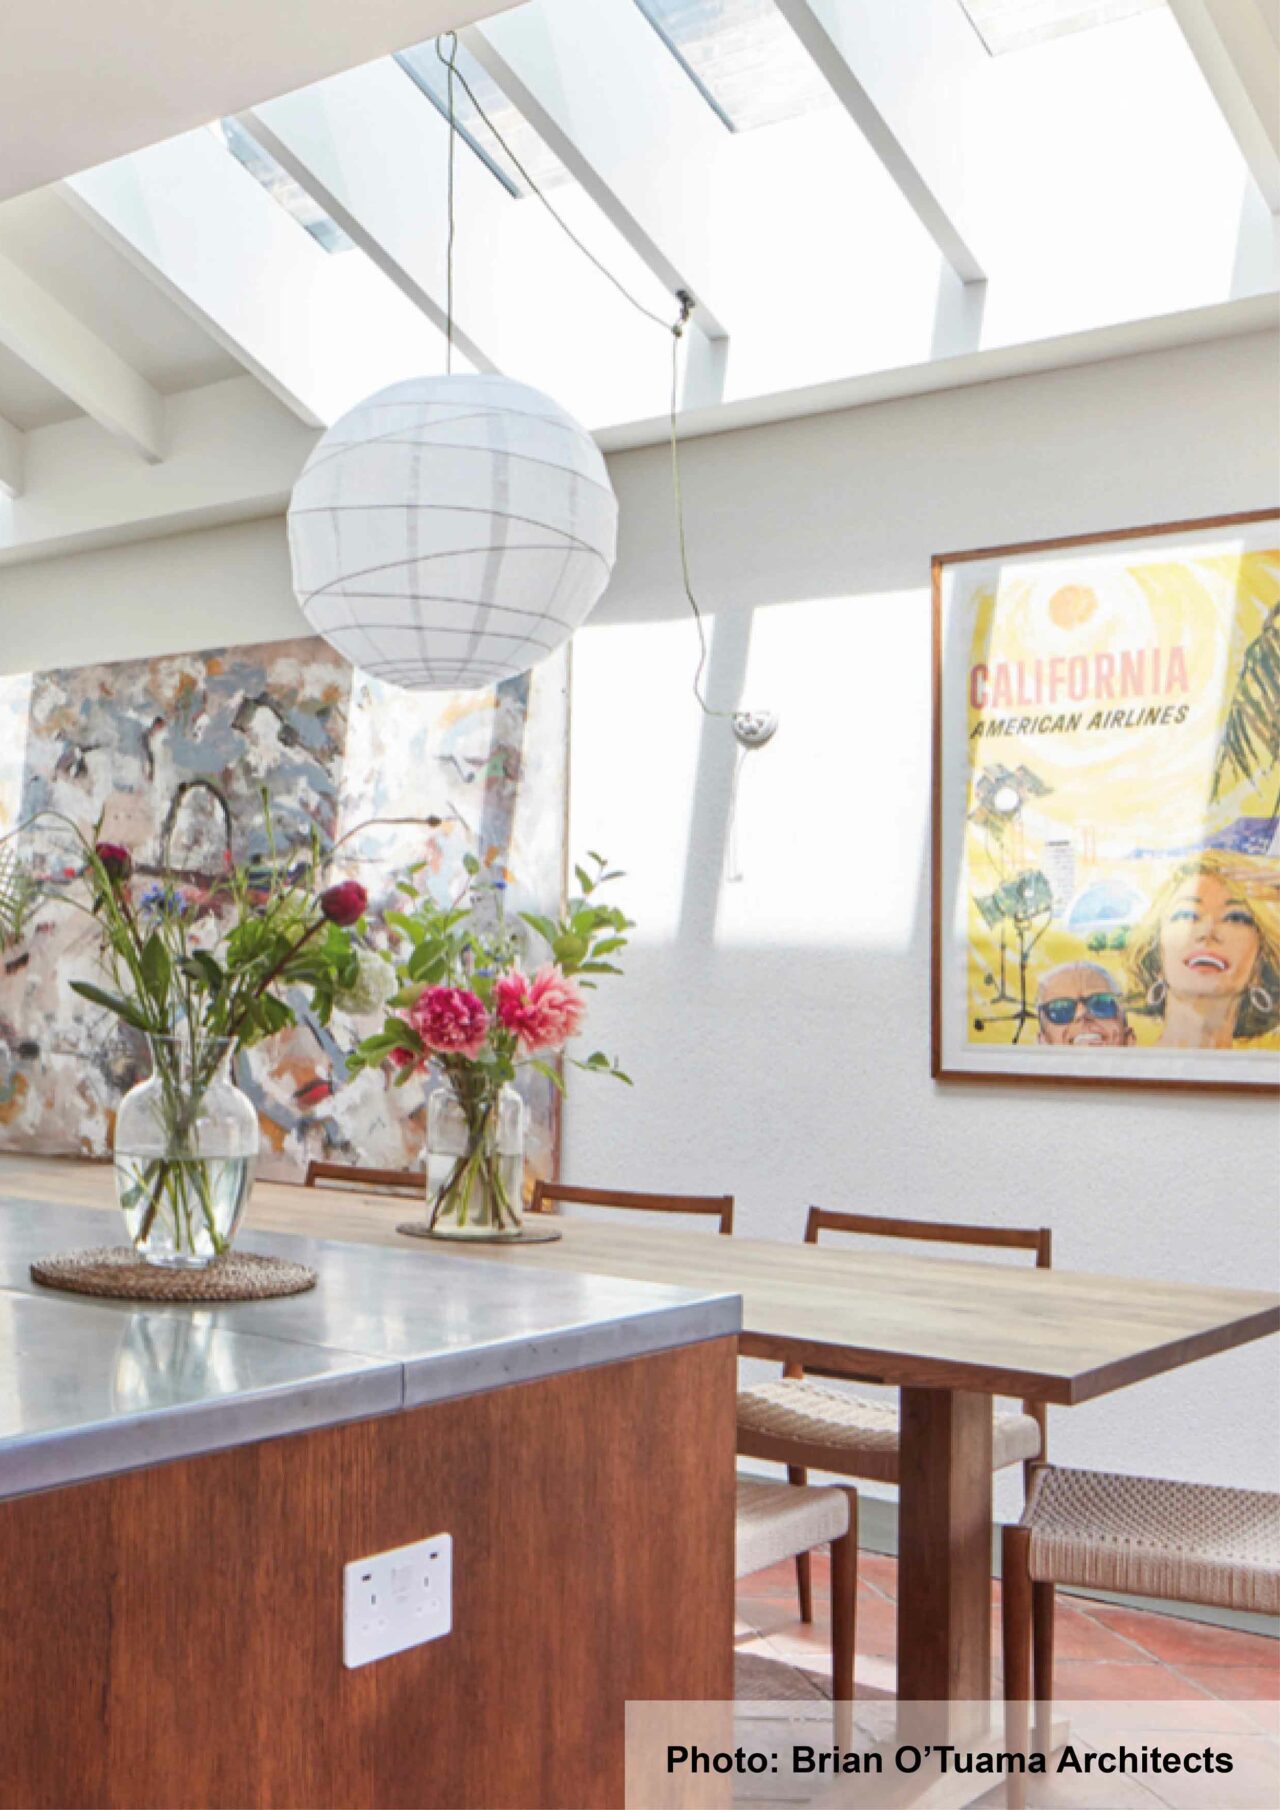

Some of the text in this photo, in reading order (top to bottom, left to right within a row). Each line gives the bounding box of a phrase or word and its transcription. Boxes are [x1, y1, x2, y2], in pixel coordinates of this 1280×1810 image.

[971, 647, 1189, 709] CALIFORNIA
[970, 705, 1189, 739] AMERICAN AIRLINES
